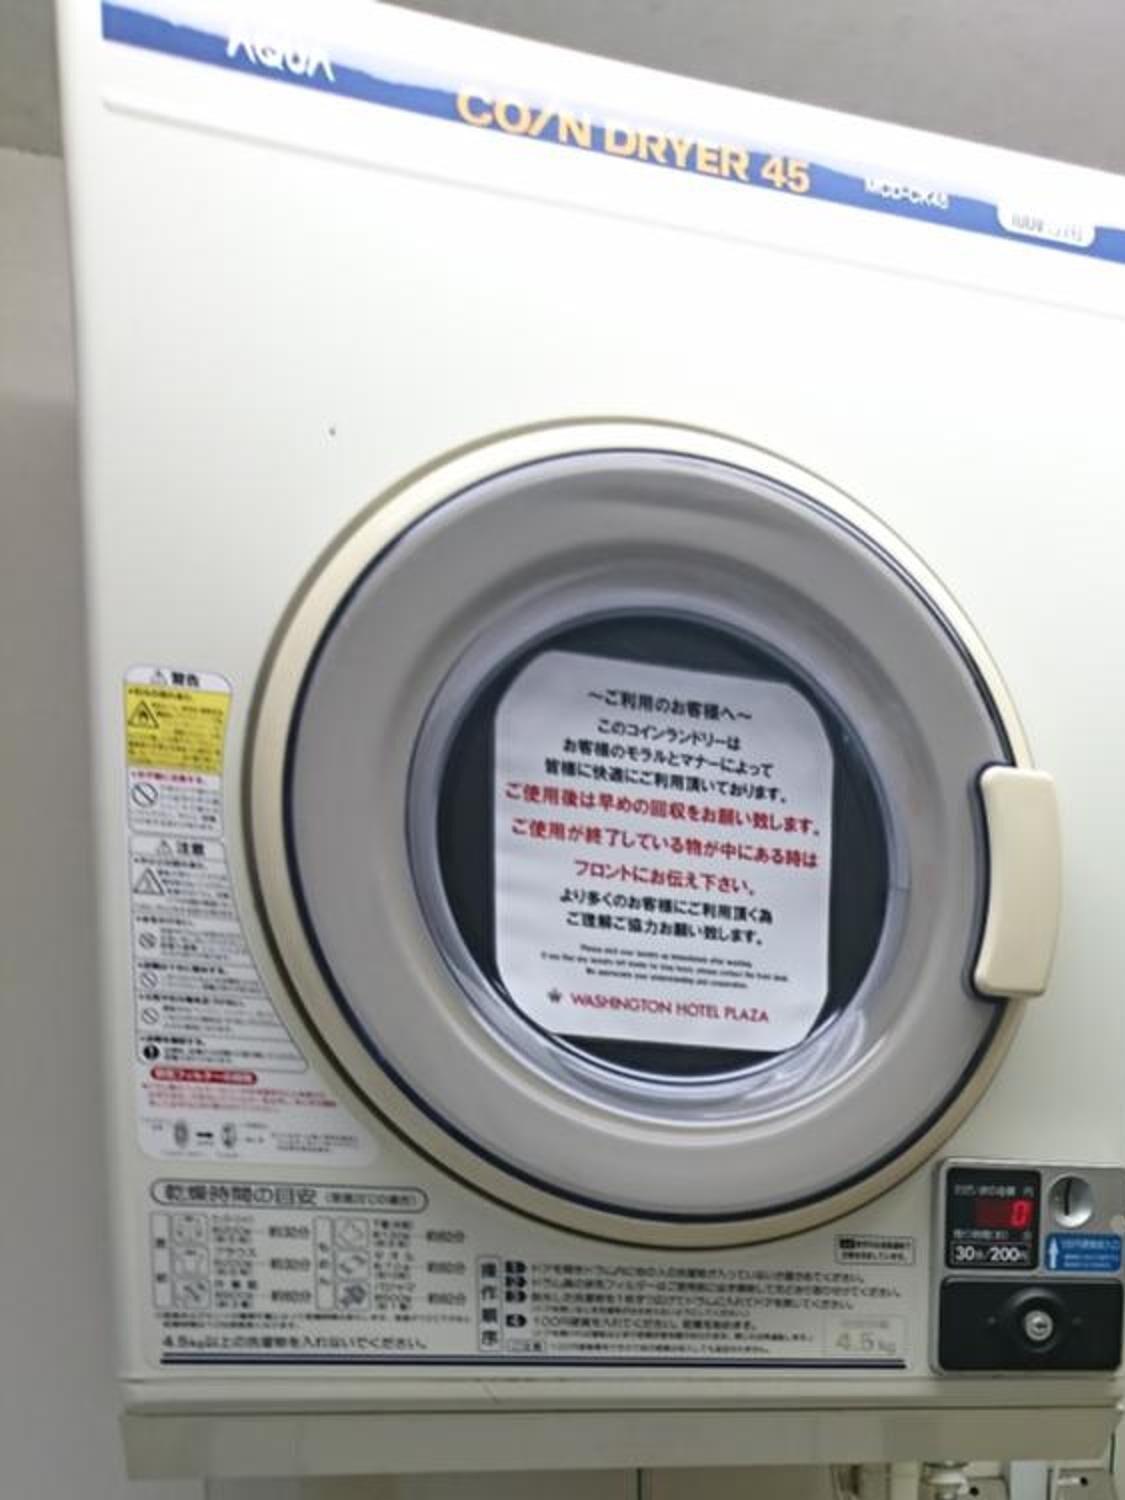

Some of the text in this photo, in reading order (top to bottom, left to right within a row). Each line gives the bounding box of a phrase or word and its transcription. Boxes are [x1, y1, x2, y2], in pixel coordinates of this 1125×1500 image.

[226, 28, 336, 81] AQUA
[602, 119, 749, 181] DRYER
[761, 157, 811, 193] 45
[596, 719, 741, 751] このコインランドリーは
[562, 739, 775, 778] お客様のモラルとマナーによって
[504, 782, 820, 837] ご使用後は早めの回収をお願い致します。
[574, 860, 757, 896] フロントにお伝え下さい。
[571, 991, 769, 1024] WASHINGTON HOTEL PLAZA
[165, 1184, 317, 1206] 乾燥時間の目安
[1011, 1200, 1031, 1228] 0
